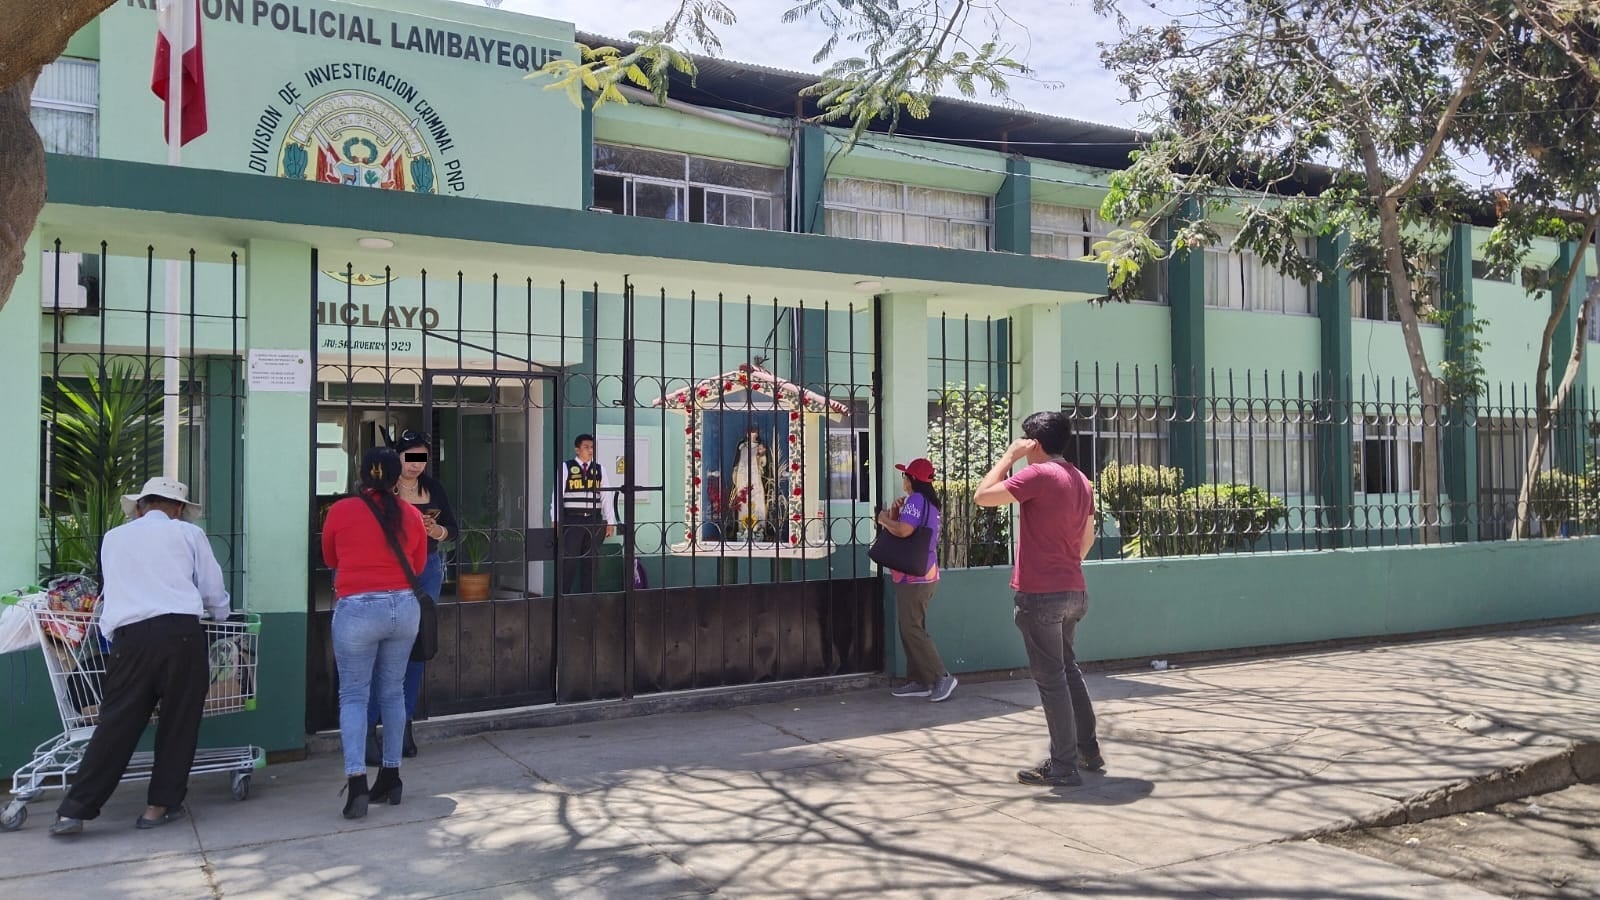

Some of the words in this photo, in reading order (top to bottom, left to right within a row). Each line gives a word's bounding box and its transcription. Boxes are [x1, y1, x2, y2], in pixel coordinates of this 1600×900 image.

[252, 0, 382, 46] POLICIAL
[248, 105, 283, 173] DIVISION
[278, 81, 301, 105] DE
[304, 63, 418, 104] INVESTIGACION
[414, 99, 454, 155] CRIMINAL
[317, 301, 440, 329] HICLAYO
[391, 341, 412, 352] 929
